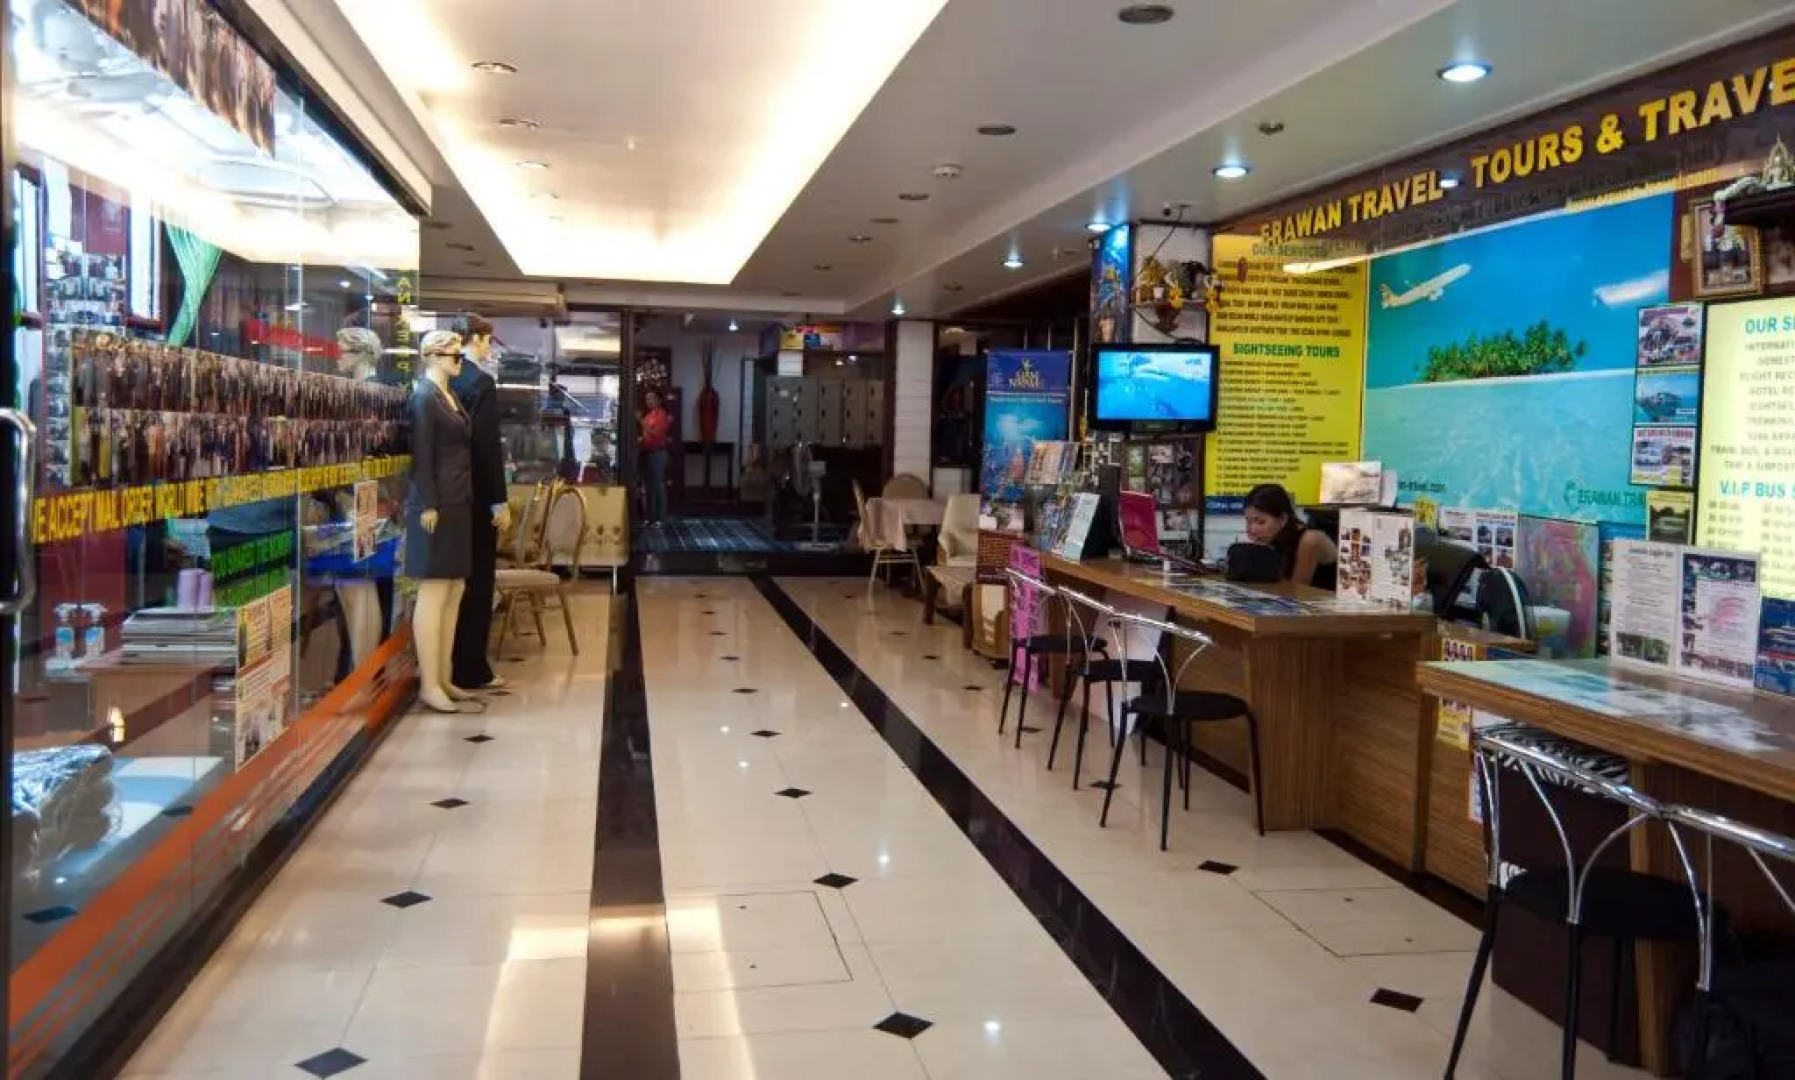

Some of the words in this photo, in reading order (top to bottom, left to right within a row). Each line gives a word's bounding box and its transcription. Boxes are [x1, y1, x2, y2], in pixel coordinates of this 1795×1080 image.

[1260, 201, 1342, 245] ERAWAN
[1349, 170, 1444, 223] TRAVEL
[1471, 125, 1584, 188] TOURS
[1597, 113, 1624, 154] &
[1639, 57, 1795, 141] TRAVE
[1745, 317, 1777, 334] OUR
[1783, 315, 1795, 331] S
[1233, 342, 1303, 356] SIGHTSEEING
[1308, 345, 1340, 358] TOURS
[1755, 482, 1785, 498] BUS
